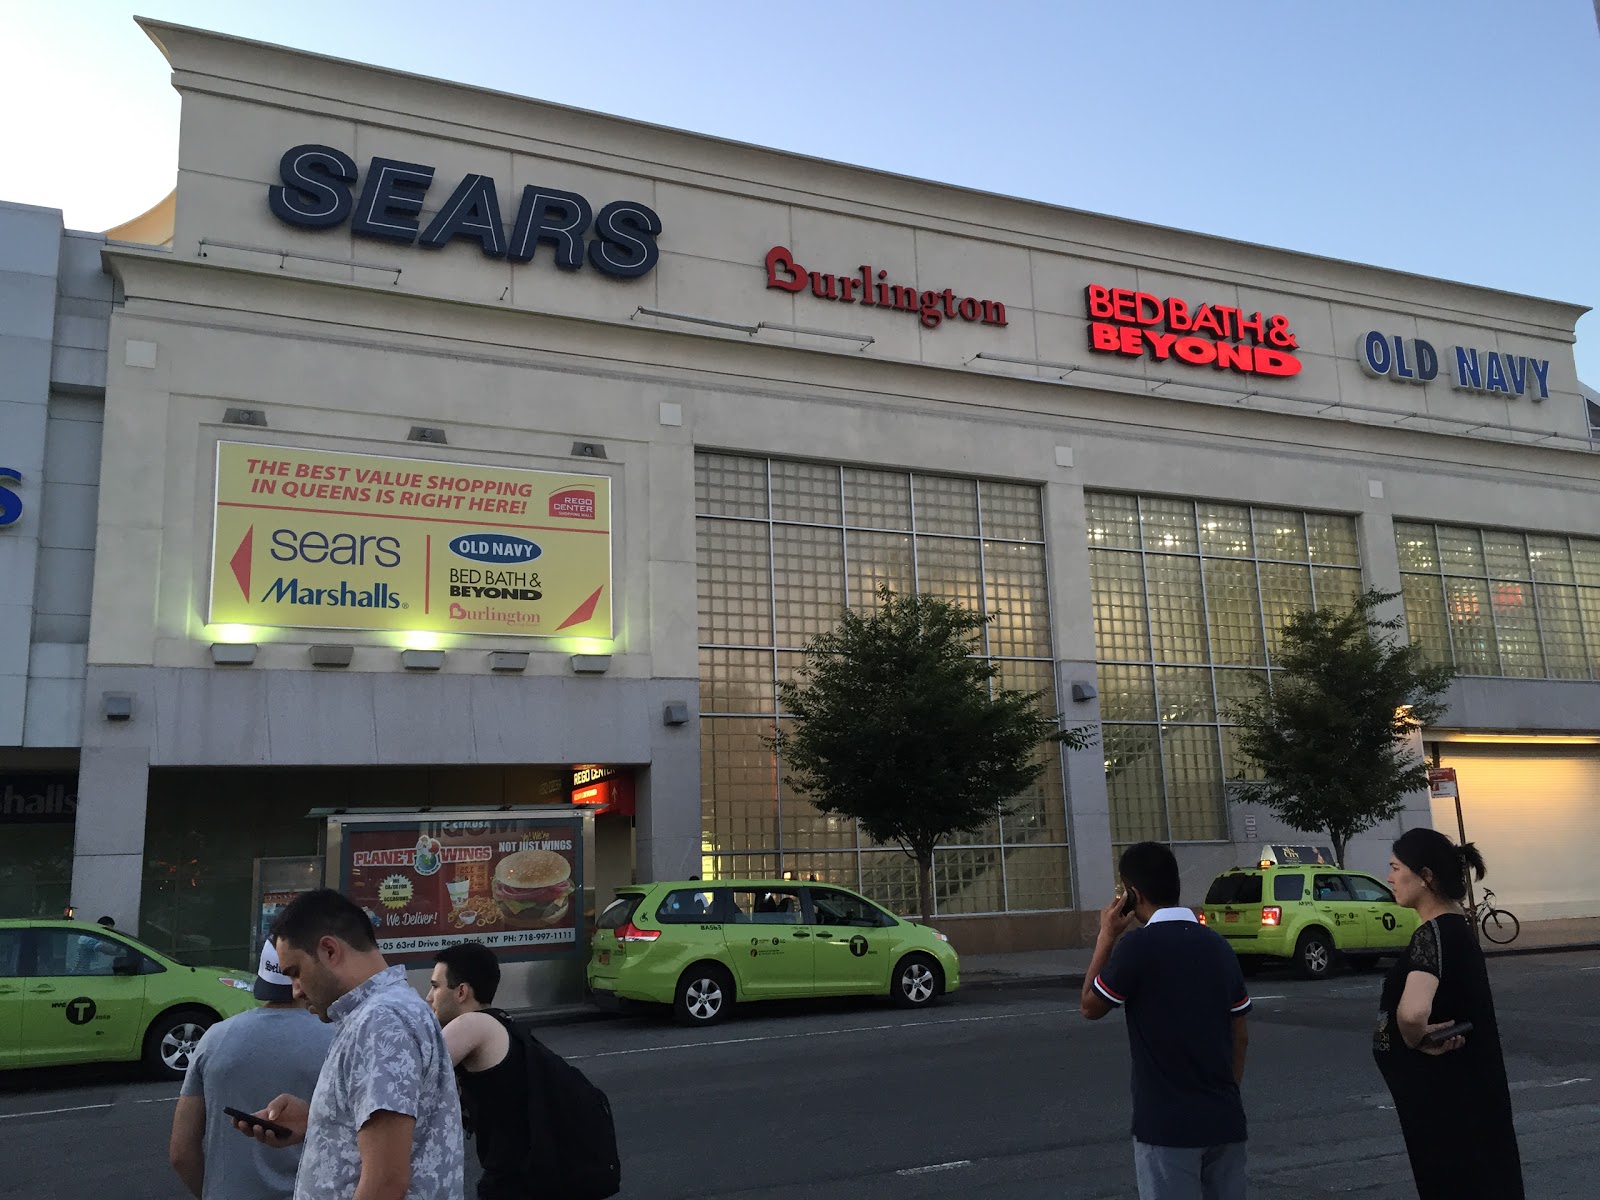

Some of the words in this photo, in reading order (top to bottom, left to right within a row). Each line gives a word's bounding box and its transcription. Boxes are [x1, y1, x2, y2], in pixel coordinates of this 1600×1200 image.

[268, 144, 662, 278] SEARS
[765, 245, 1008, 328] Burlington
[1086, 283, 1165, 326] BED
[1166, 297, 1264, 343] BATH
[1266, 314, 1300, 349] &
[1090, 321, 1303, 378] BEYOND
[1360, 329, 1440, 383] OLD
[1452, 344, 1550, 400] NAVY
[247, 459, 291, 476] THE
[295, 463, 351, 482] BEST
[355, 468, 423, 488] VALUE
[427, 475, 533, 497] SHOPPING
[251, 478, 277, 494] IN
[281, 481, 371, 503] QUEENS
[375, 489, 395, 504] IS
[399, 491, 465, 510] RIGHT
[468, 496, 528, 515] HERE!
[553, 503, 593, 512] CENTER
[564, 497, 593, 505] REGO
[270, 529, 401, 567] sears
[459, 540, 489, 554] OLD
[492, 542, 533, 558] NAVY
[450, 568, 481, 584] BED
[485, 570, 526, 587] BATH
[529, 572, 542, 588] &
[260, 577, 401, 609] Marshalls
[450, 585, 543, 600] BEYOND
[449, 602, 541, 626] Burlington
[573, 769, 591, 786] REGO
[0, 784, 77, 814] halls
[452, 821, 491, 829] CEMUSA
[355, 849, 417, 865] PLANET
[441, 847, 492, 862] WINGS
[499, 841, 518, 852] NOT
[519, 840, 540, 851] JUST
[541, 839, 572, 851] WINGS
[386, 913, 400, 926] We
[402, 912, 438, 926] Deliver!
[396, 940, 416, 949] 63rd
[418, 939, 439, 948] Drive
[464, 936, 484, 945] Park,
[487, 936, 499, 944] NY
[519, 931, 572, 942] 718-997-1111
